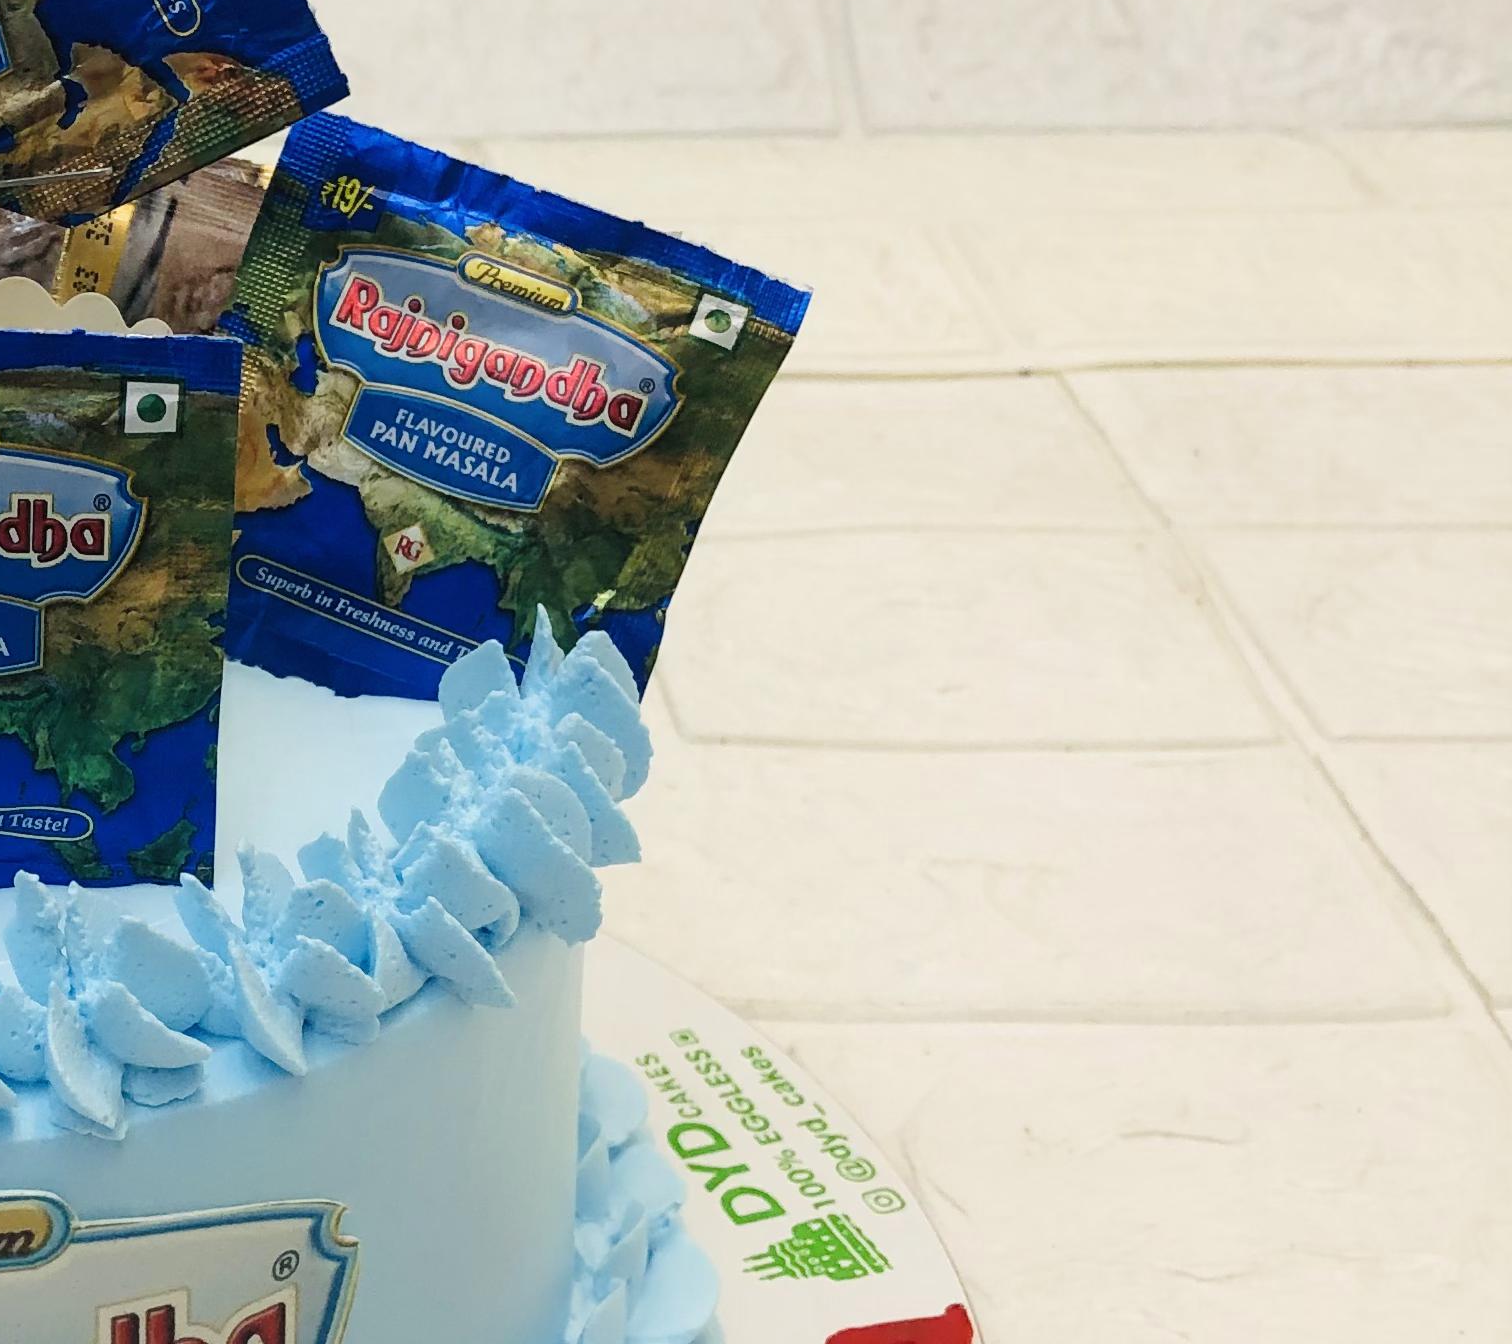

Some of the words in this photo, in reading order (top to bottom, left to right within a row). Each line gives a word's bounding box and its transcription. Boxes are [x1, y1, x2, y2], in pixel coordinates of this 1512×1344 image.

[467, 261, 566, 311] Premium
[336, 275, 644, 432] Rajnigandha
[369, 420, 419, 454] PAN
[423, 440, 518, 494] MASALA
[395, 408, 511, 464] FLAVOURED
[255, 566, 312, 600] Superb
[315, 590, 333, 609] in
[334, 596, 416, 642] Freshness
[418, 634, 453, 657] and
[9, 813, 70, 832] Taste!
[634, 1052, 703, 1119] CAKES
[684, 1048, 783, 1146] EGGLESS
[740, 1045, 877, 1183] @dyd_cakes
[666, 1122, 787, 1226] DYD
[774, 1149, 836, 1210] 100%
